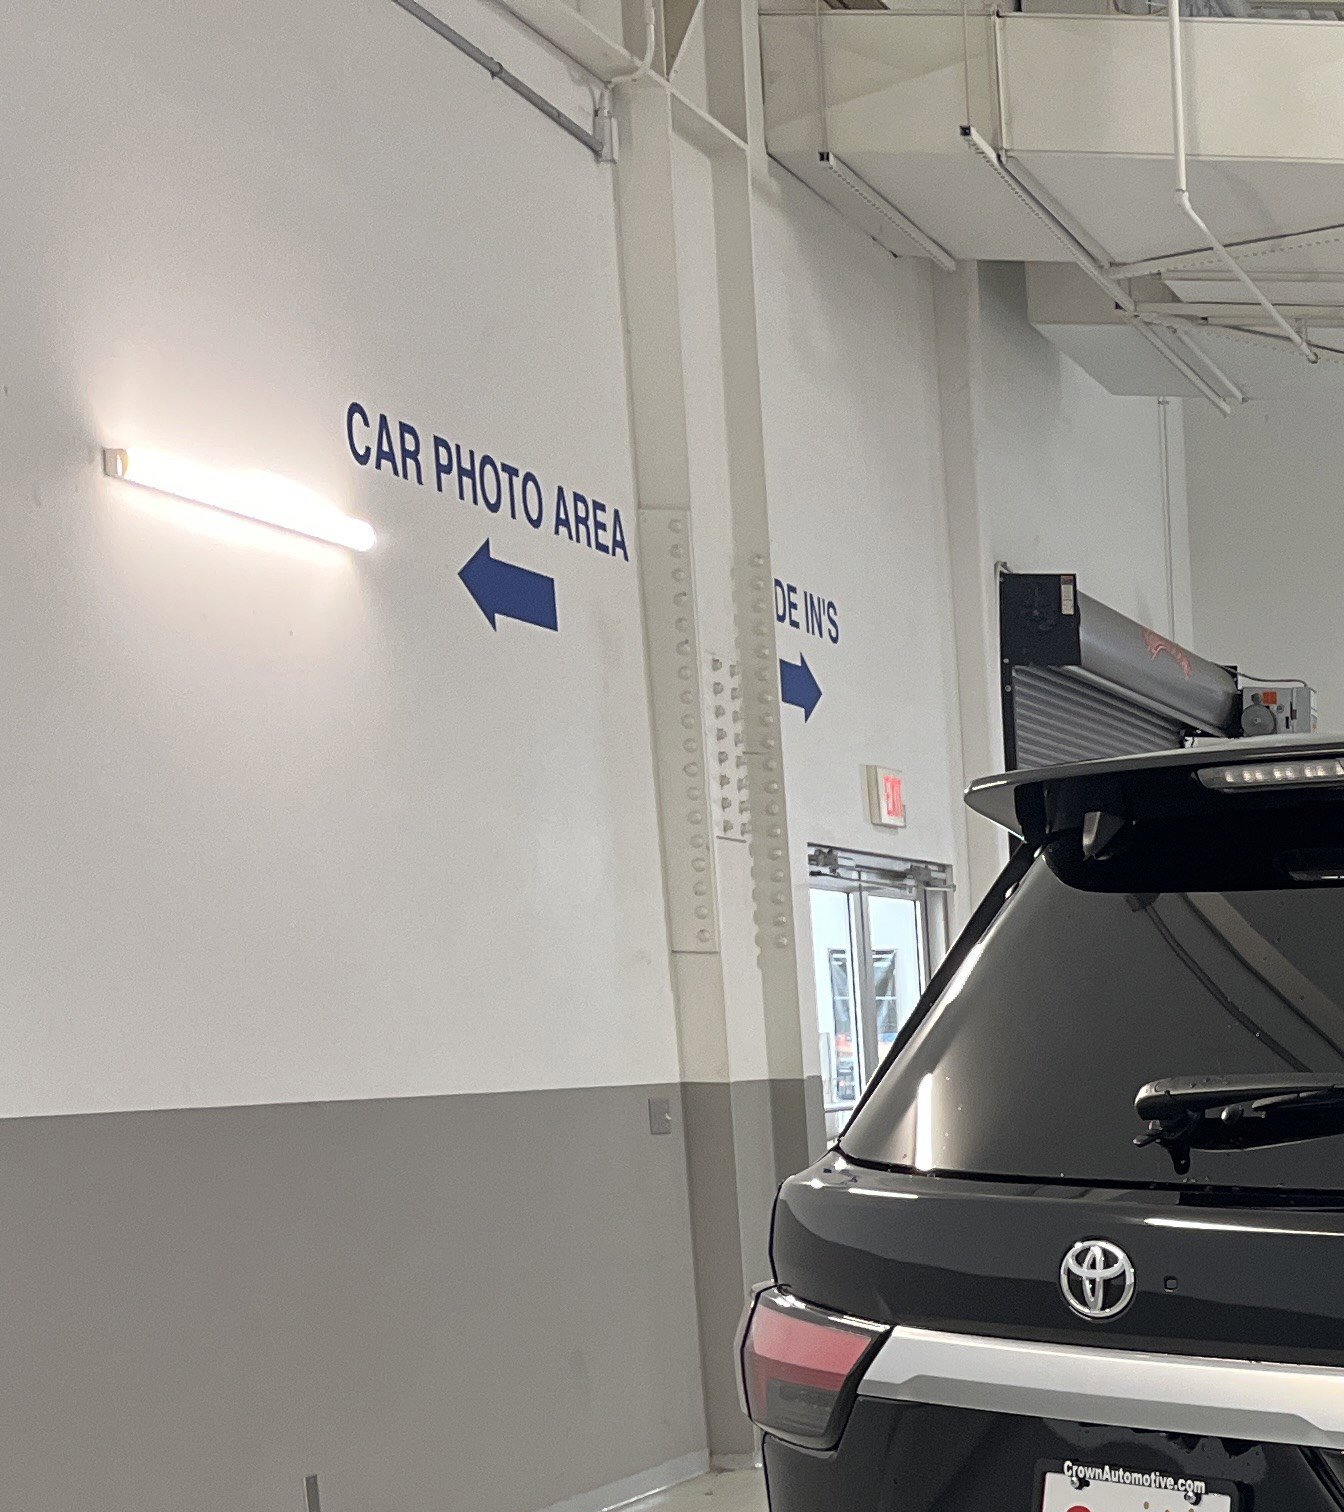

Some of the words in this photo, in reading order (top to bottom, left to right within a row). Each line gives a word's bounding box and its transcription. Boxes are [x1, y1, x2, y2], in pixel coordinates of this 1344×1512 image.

[346, 402, 423, 486] CAR
[432, 434, 544, 529] PHOTO
[553, 485, 630, 562] AREA
[774, 578, 800, 630] DE
[803, 590, 839, 644] IN'S
[1063, 1460, 1206, 1494] CrownAutomotive.com
